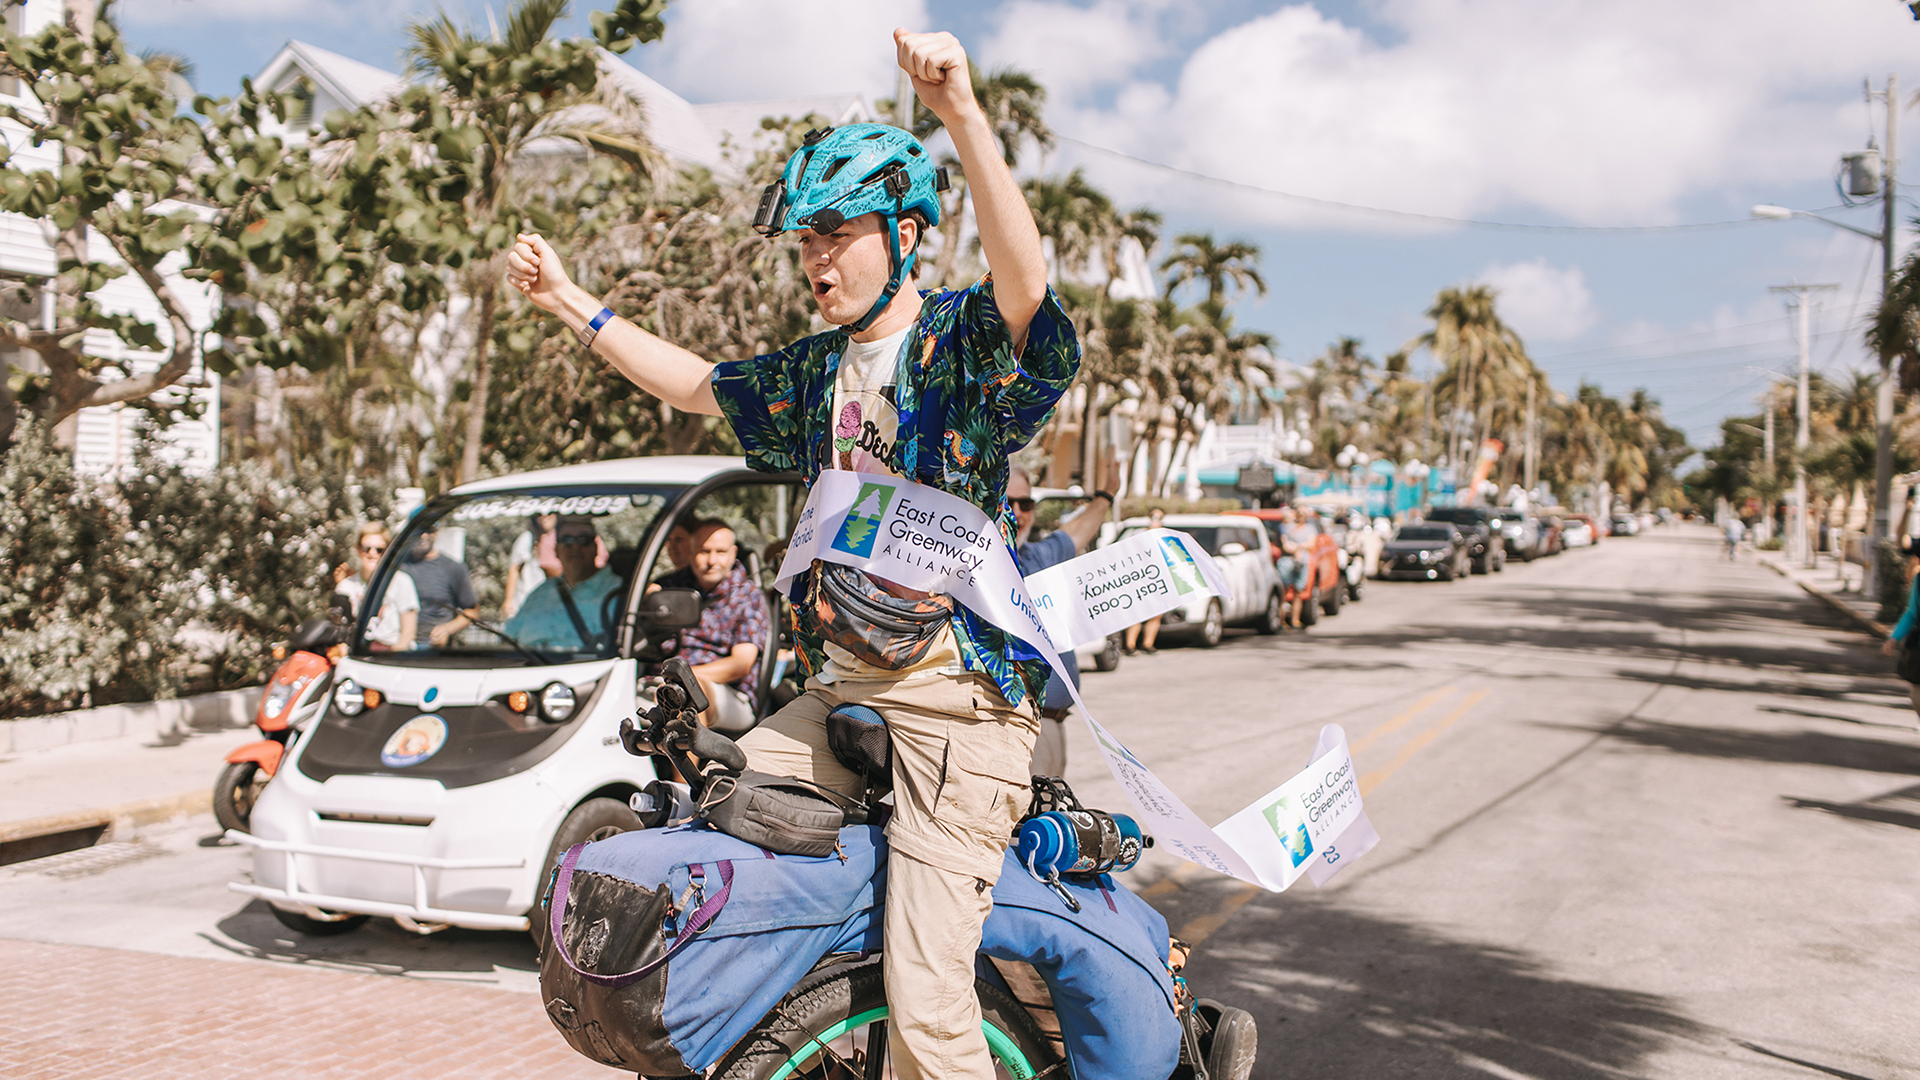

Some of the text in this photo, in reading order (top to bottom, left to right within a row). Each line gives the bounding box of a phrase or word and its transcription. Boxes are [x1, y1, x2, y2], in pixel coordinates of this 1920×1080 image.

[453, 496, 631, 521] 305-294-0995
[895, 498, 992, 552] East Coast
[882, 544, 977, 588] ALLIANCE
[889, 519, 984, 573] Greenway
[1076, 548, 1152, 586] ALLIANCE
[1033, 594, 1054, 610] Un
[1082, 563, 1161, 601] Greenway
[1087, 578, 1169, 620] East Coast
[1299, 756, 1351, 809] East Coast
[1308, 774, 1355, 823] Greenway
[1315, 789, 1358, 839] ALLIANCE
